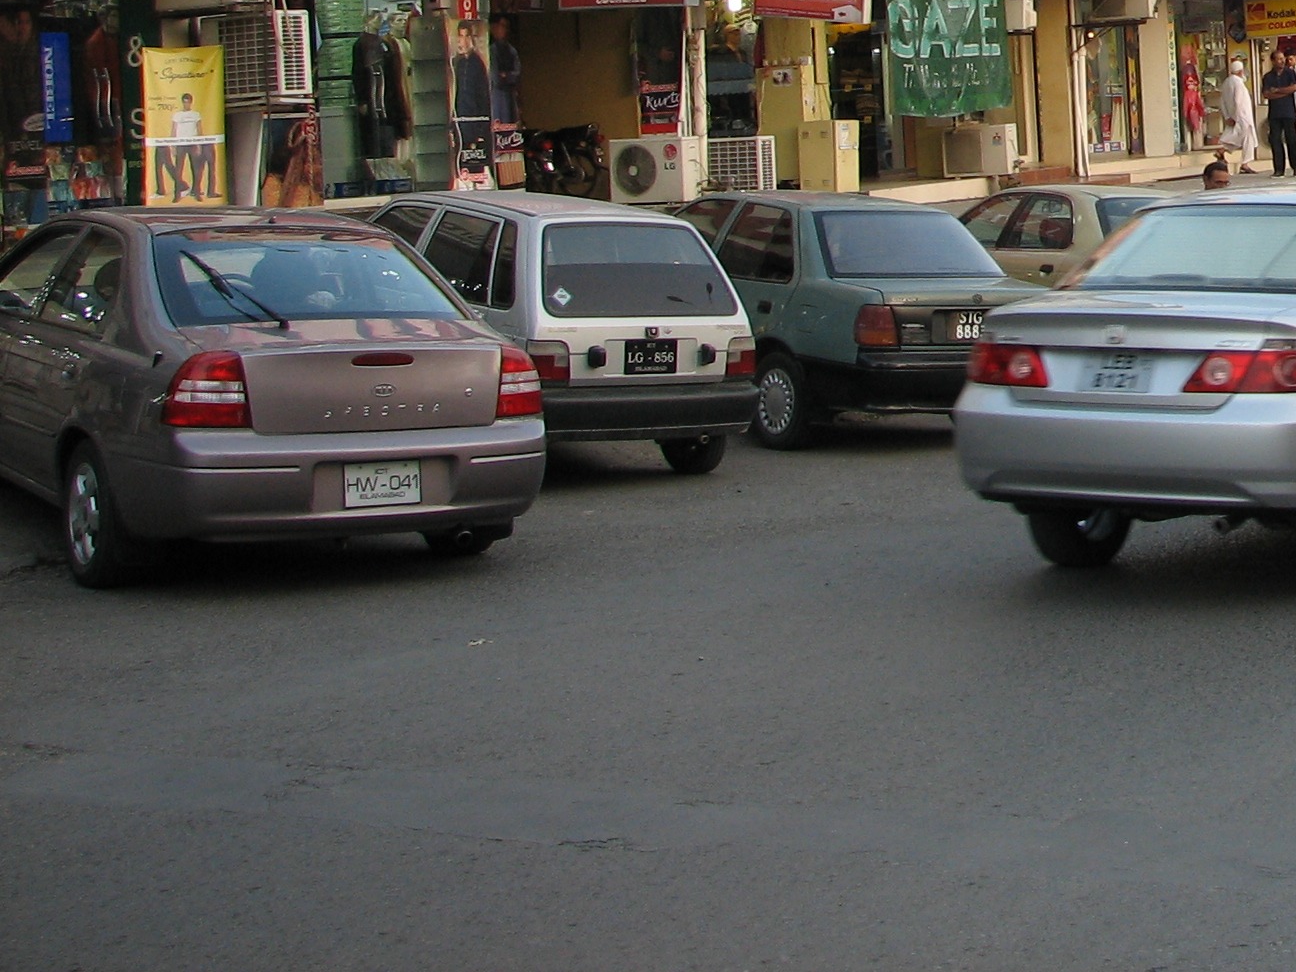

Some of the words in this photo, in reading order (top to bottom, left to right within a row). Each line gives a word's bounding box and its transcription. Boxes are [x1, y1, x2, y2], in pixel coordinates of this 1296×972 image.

[1266, 8, 1296, 19] Kodak
[1267, 19, 1296, 30] COLOR
[663, 161, 676, 171] LG
[628, 352, 644, 364] LG
[653, 351, 674, 363] 856
[346, 473, 419, 493] HW-041
